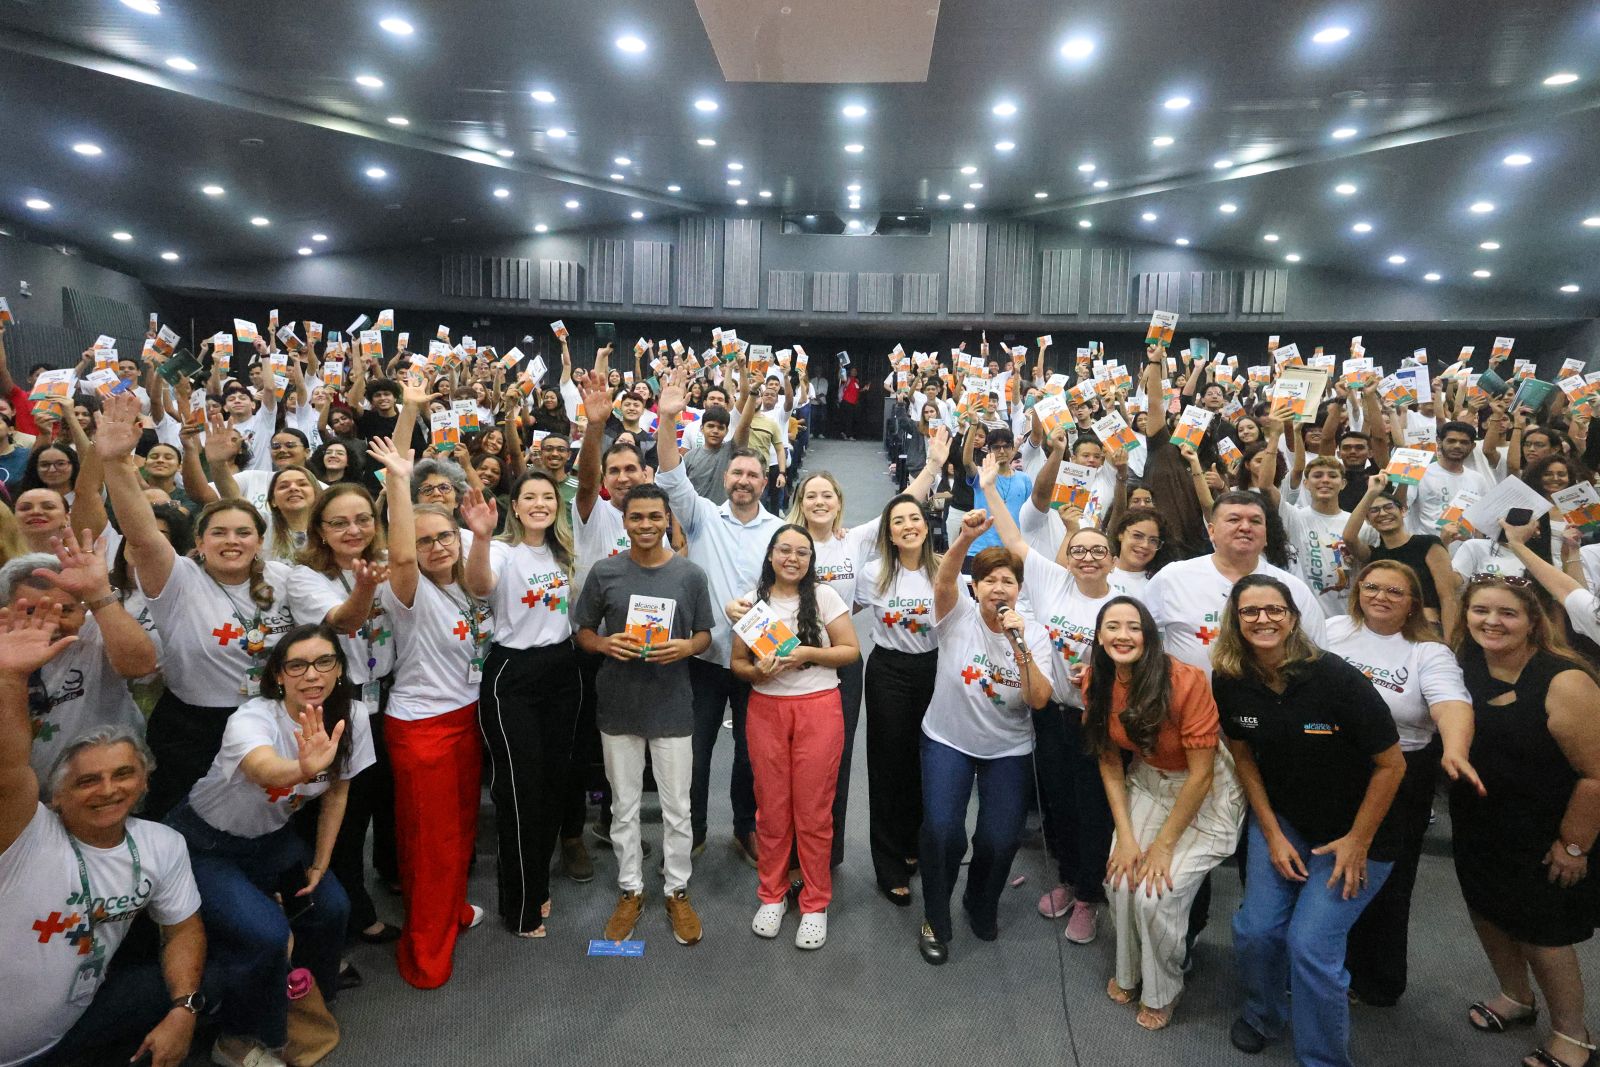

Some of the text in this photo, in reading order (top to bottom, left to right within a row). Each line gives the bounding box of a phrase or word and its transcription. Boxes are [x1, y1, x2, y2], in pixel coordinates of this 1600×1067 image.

[617, 537, 631, 548] alc
[1308, 530, 1324, 591] alcance
[817, 565, 843, 574] ance
[1204, 610, 1218, 622] al
[1051, 615, 1096, 637] alcance
[1240, 716, 1258, 724] LECE
[66, 892, 129, 910] alnce
